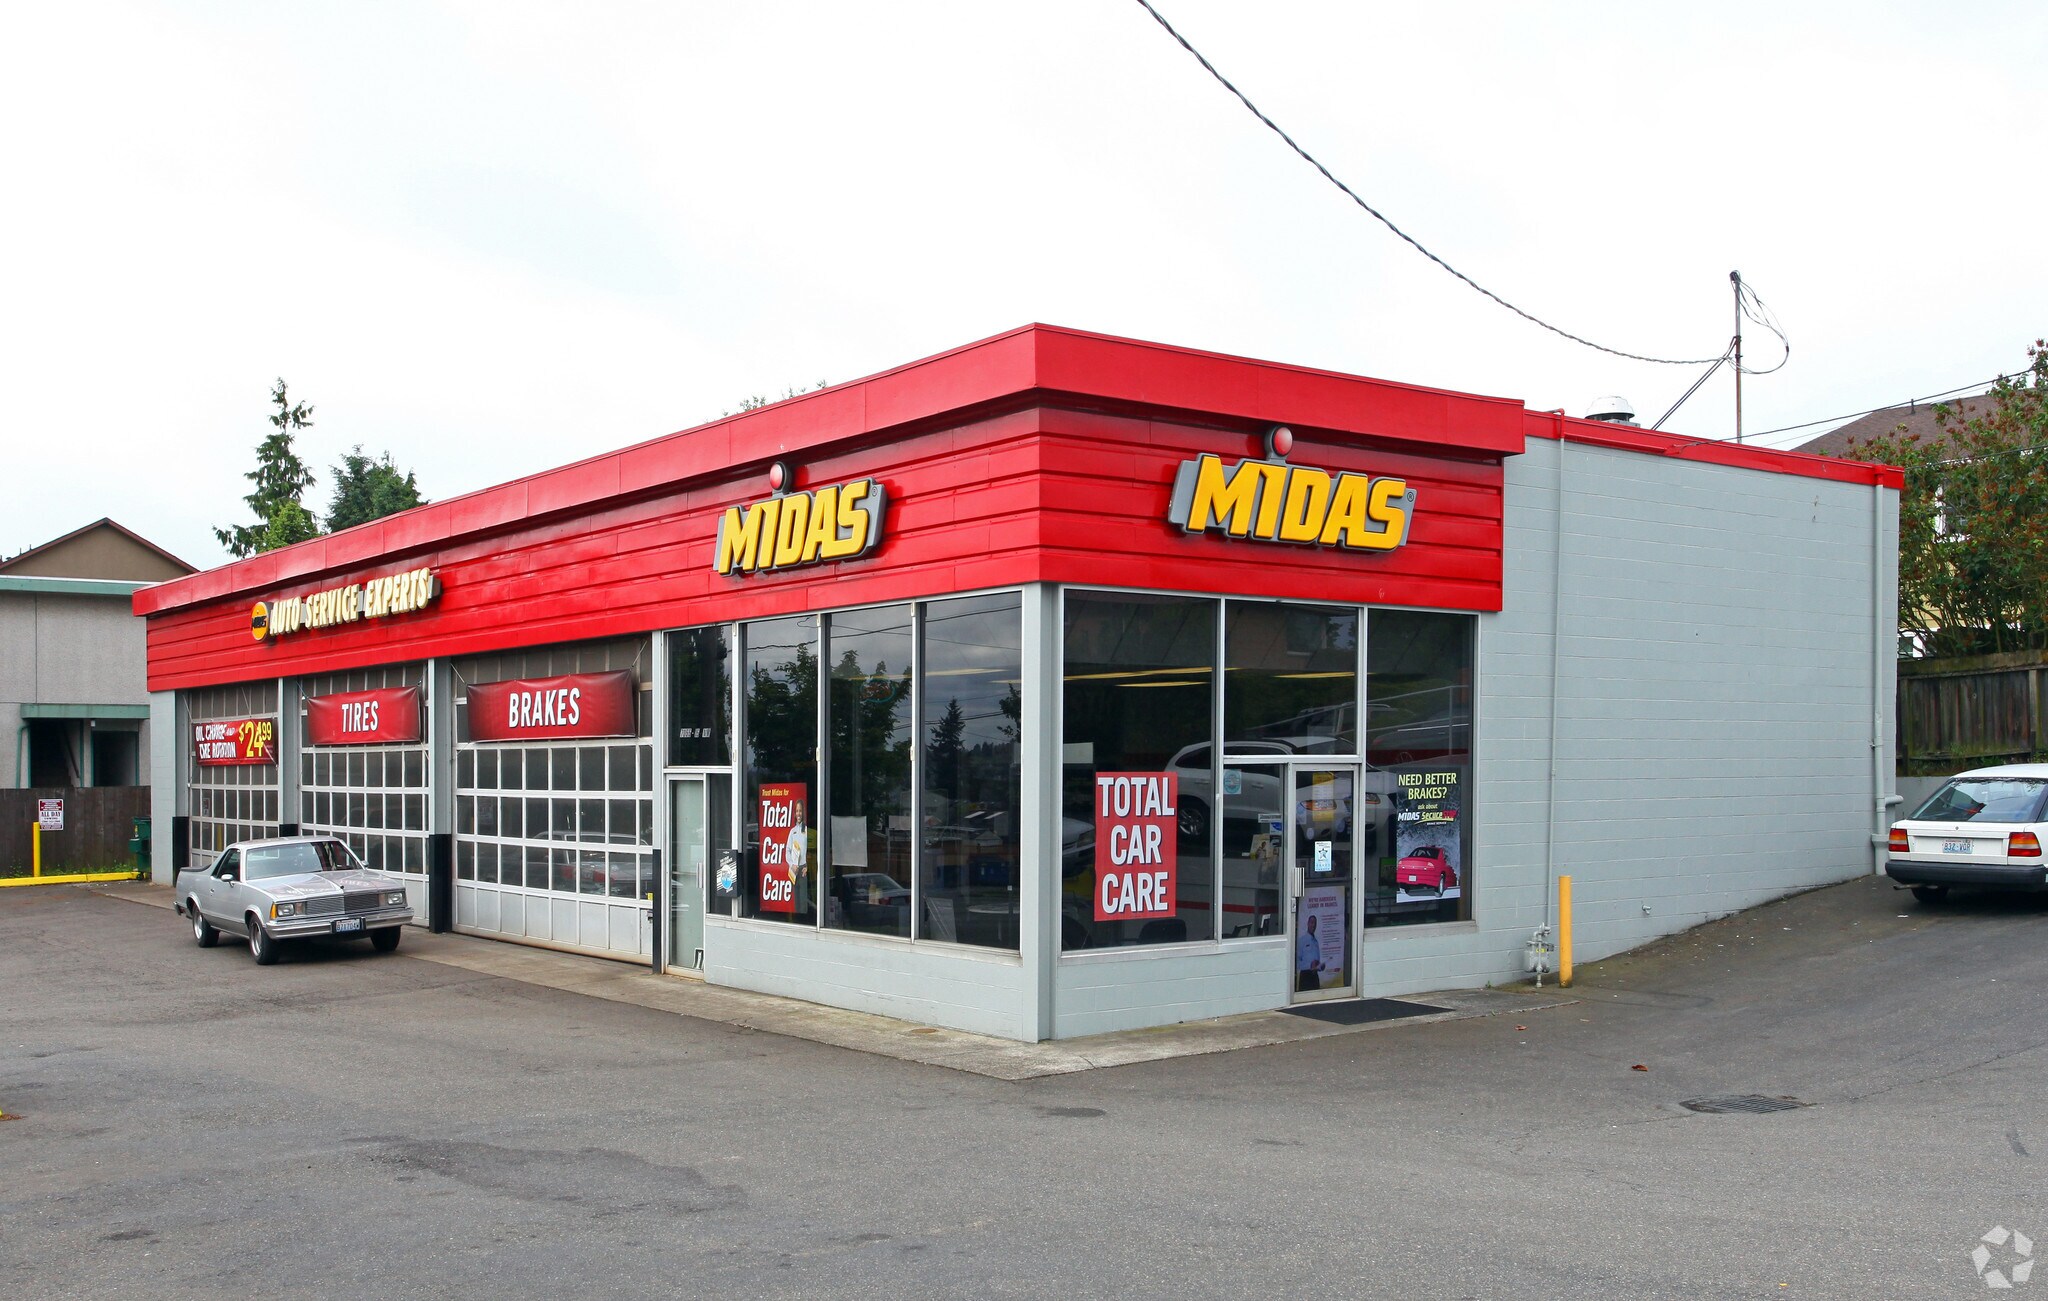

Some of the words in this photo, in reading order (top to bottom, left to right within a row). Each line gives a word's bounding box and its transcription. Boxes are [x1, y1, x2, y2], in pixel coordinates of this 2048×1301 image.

[1187, 455, 1407, 550] MIDAS
[718, 480, 869, 574] MIDAS
[270, 597, 301, 635] AUTO
[305, 584, 361, 628] SERVICE
[365, 567, 430, 618] EXPERTS
[341, 700, 379, 733] TIRES
[509, 687, 580, 728] BRAKES
[1098, 776, 1175, 818] TOTAL
[1398, 774, 1422, 786] NEED
[1425, 772, 1457, 785] BETTER
[1408, 787, 1448, 800] BRAKES?
[762, 800, 793, 828] Total
[1397, 809, 1420, 821] MIDAS
[762, 837, 785, 865] Car
[1110, 824, 1162, 866] CAR
[762, 873, 792, 902] Care
[1102, 871, 1169, 914] CARE
